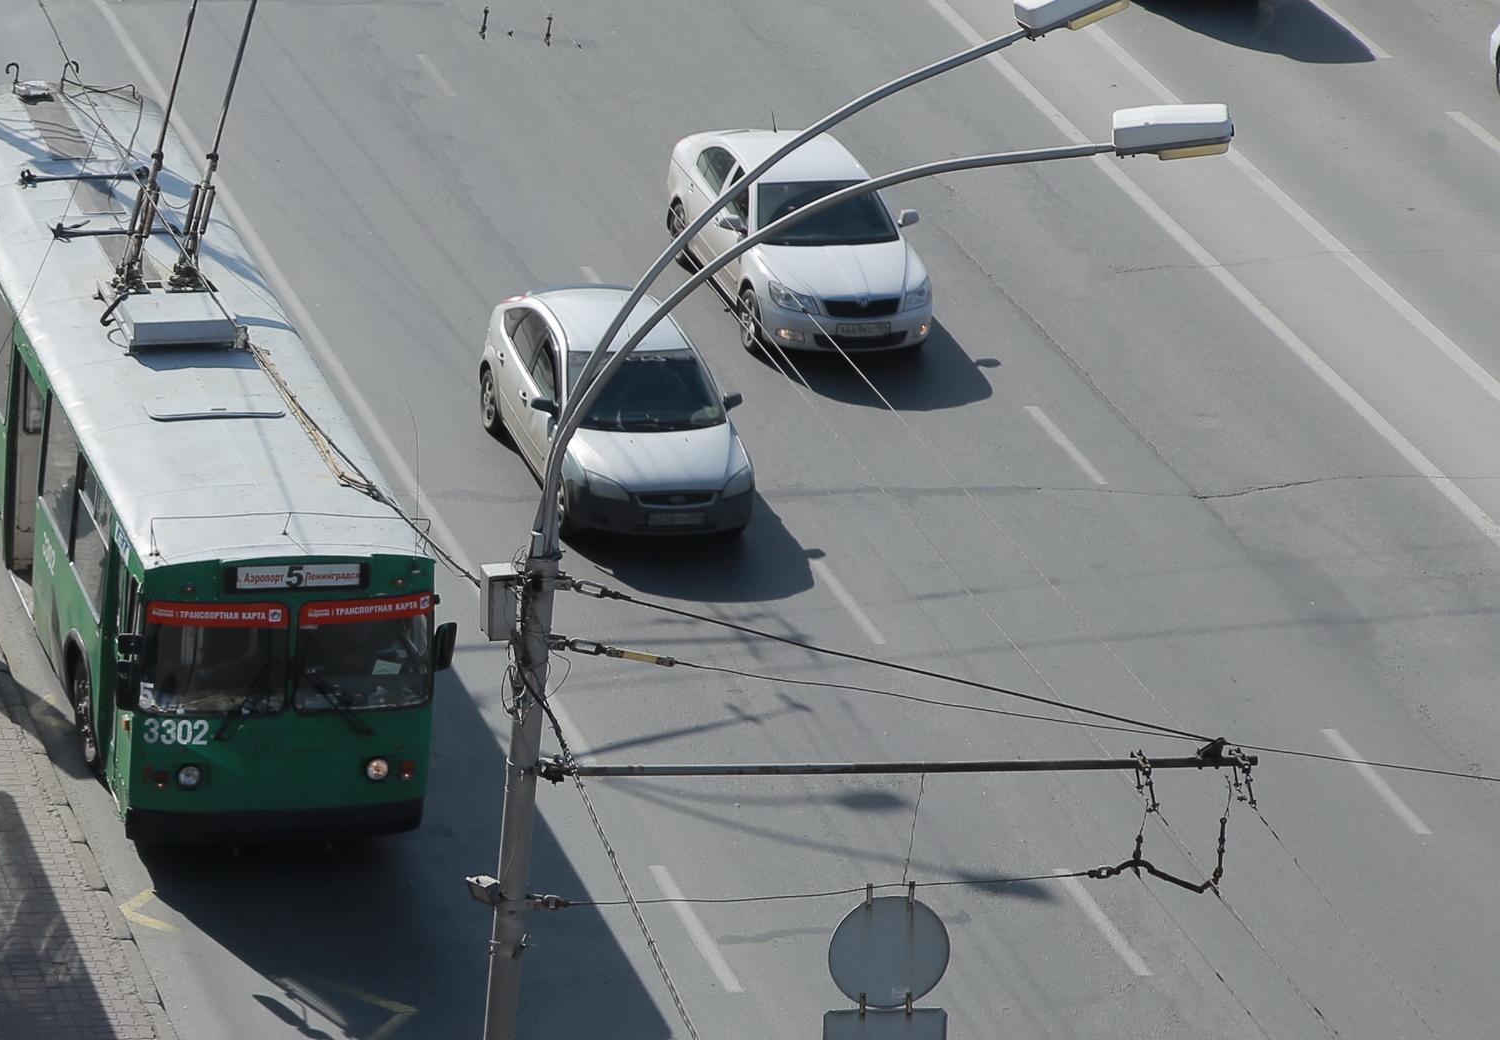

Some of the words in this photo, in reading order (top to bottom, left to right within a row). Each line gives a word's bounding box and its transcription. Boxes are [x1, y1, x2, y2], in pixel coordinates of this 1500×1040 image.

[243, 572, 284, 585] Аэропорт
[285, 565, 304, 589] 5
[180, 610, 239, 620] ТРАНСПОРТНАЯ
[241, 611, 266, 620] КАРТА
[335, 605, 393, 617] ТРАНСПОРТНАЯ
[395, 601, 418, 611] КАРТА
[139, 681, 154, 709] 5
[143, 718, 209, 745] 3302
